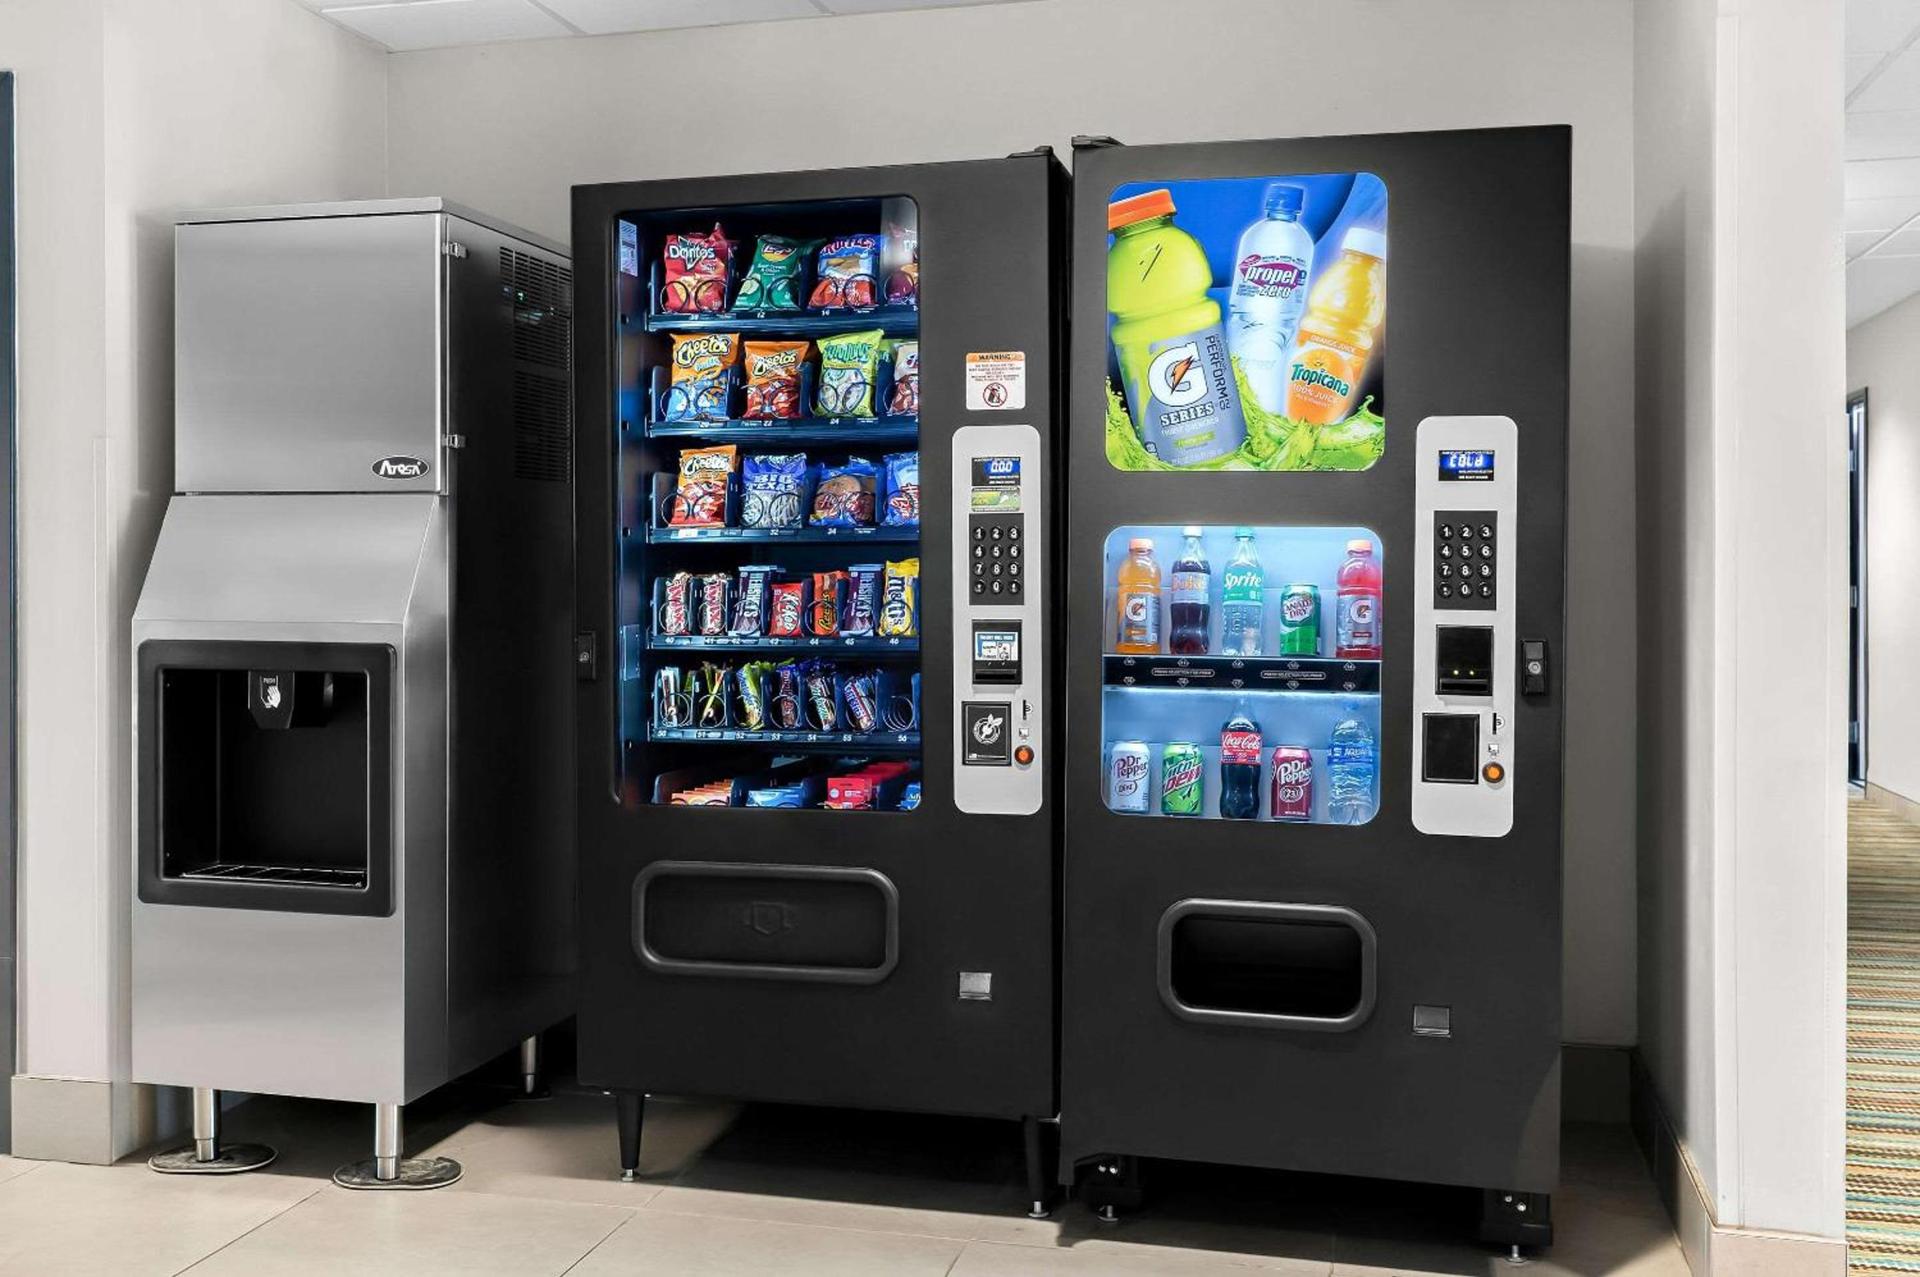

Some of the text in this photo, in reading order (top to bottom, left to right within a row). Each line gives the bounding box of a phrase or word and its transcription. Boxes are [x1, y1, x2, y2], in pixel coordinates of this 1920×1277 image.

[669, 245, 716, 260] Doritos
[1244, 266, 1299, 287] propel
[1259, 284, 1291, 299] zero
[678, 335, 729, 367] Cheetos
[753, 350, 798, 376] Cheetos
[1205, 335, 1229, 400] PERFORM
[1291, 363, 1350, 397] Tropicana
[1160, 402, 1216, 428] SERIES
[684, 454, 730, 475] Cheetos
[976, 529, 1017, 539] 1 2 3
[1443, 527, 1490, 537] 1 2 3
[976, 547, 1017, 556] 4 5 6
[1443, 546, 1489, 556] 4 5 6
[976, 564, 1017, 574] 7 8 9
[1443, 566, 1488, 575] 7 8 9
[993, 582, 999, 591] 0
[1225, 572, 1262, 590] Sprite
[1461, 585, 1467, 594] 0
[1290, 608, 1308, 619] DRY
[1126, 756, 1141, 766] Dr
[1291, 760, 1306, 773] Dr
[1114, 759, 1148, 779] Pepper
[1277, 763, 1311, 785] Pepper
